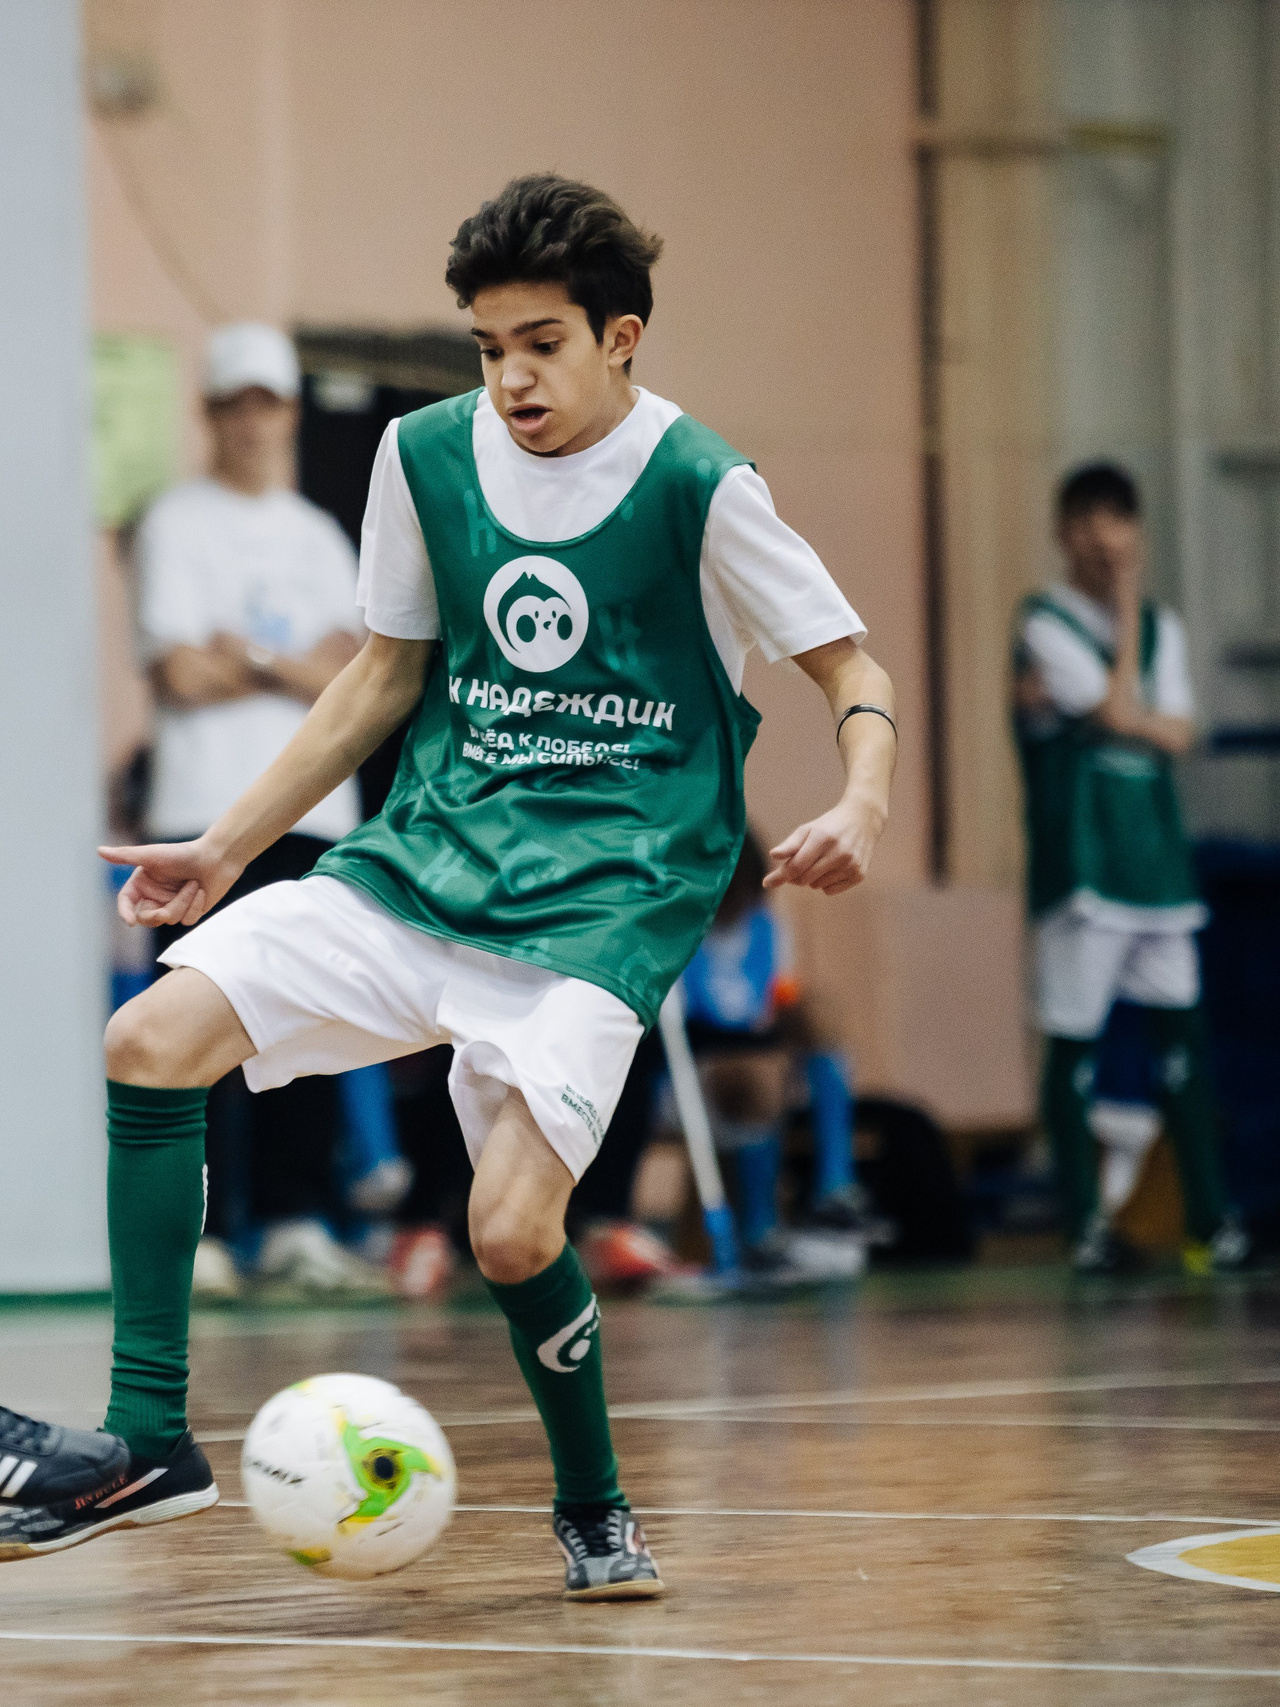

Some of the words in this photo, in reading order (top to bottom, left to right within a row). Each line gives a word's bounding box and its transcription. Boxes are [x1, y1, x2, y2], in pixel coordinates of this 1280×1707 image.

[449, 675, 463, 704] К
[466, 679, 676, 731] НАДЕЖДИК
[518, 732, 533, 747] К
[500, 751, 534, 765] МЫ
